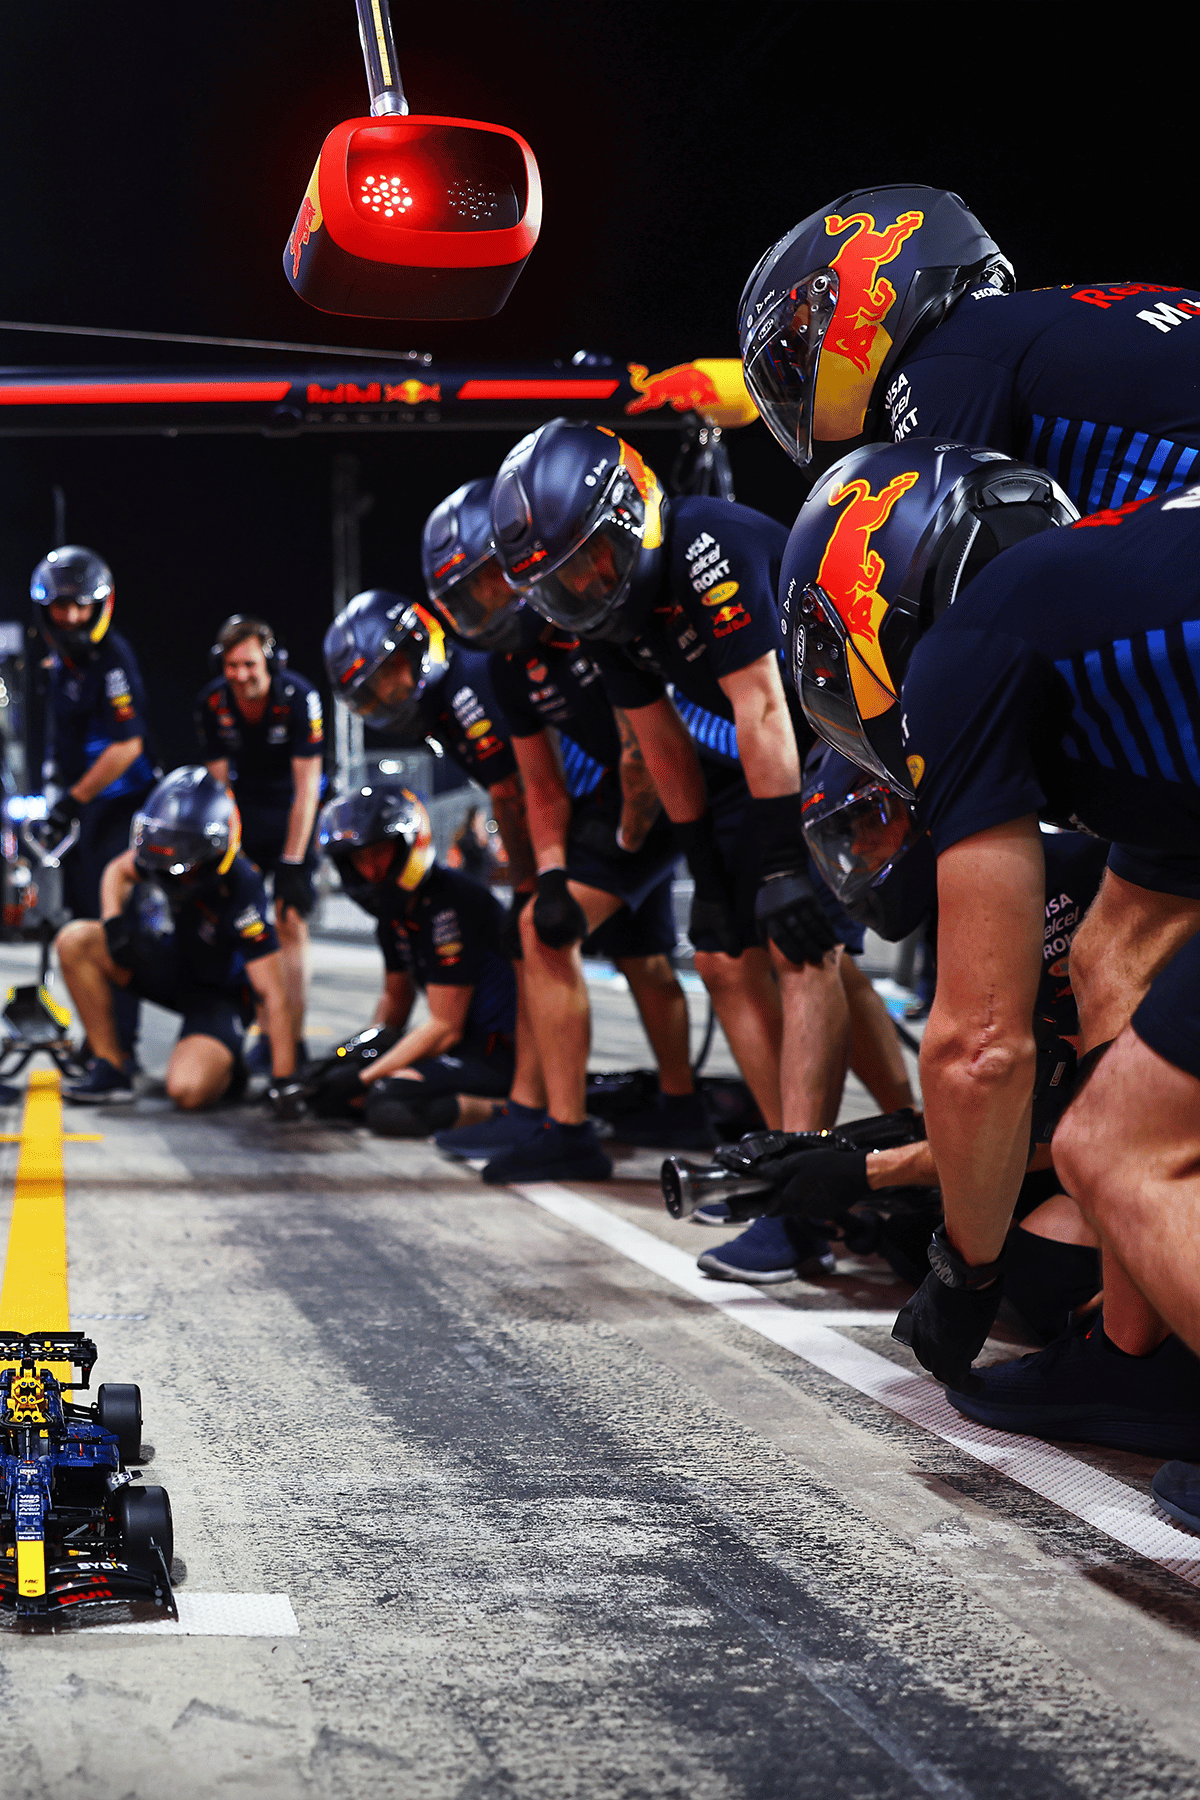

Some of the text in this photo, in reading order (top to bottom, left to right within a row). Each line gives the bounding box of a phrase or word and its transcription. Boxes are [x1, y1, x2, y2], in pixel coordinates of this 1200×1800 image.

[692, 559, 730, 593] ROKT
[1045, 893, 1074, 918] ISA
[1045, 906, 1079, 940] elcel
